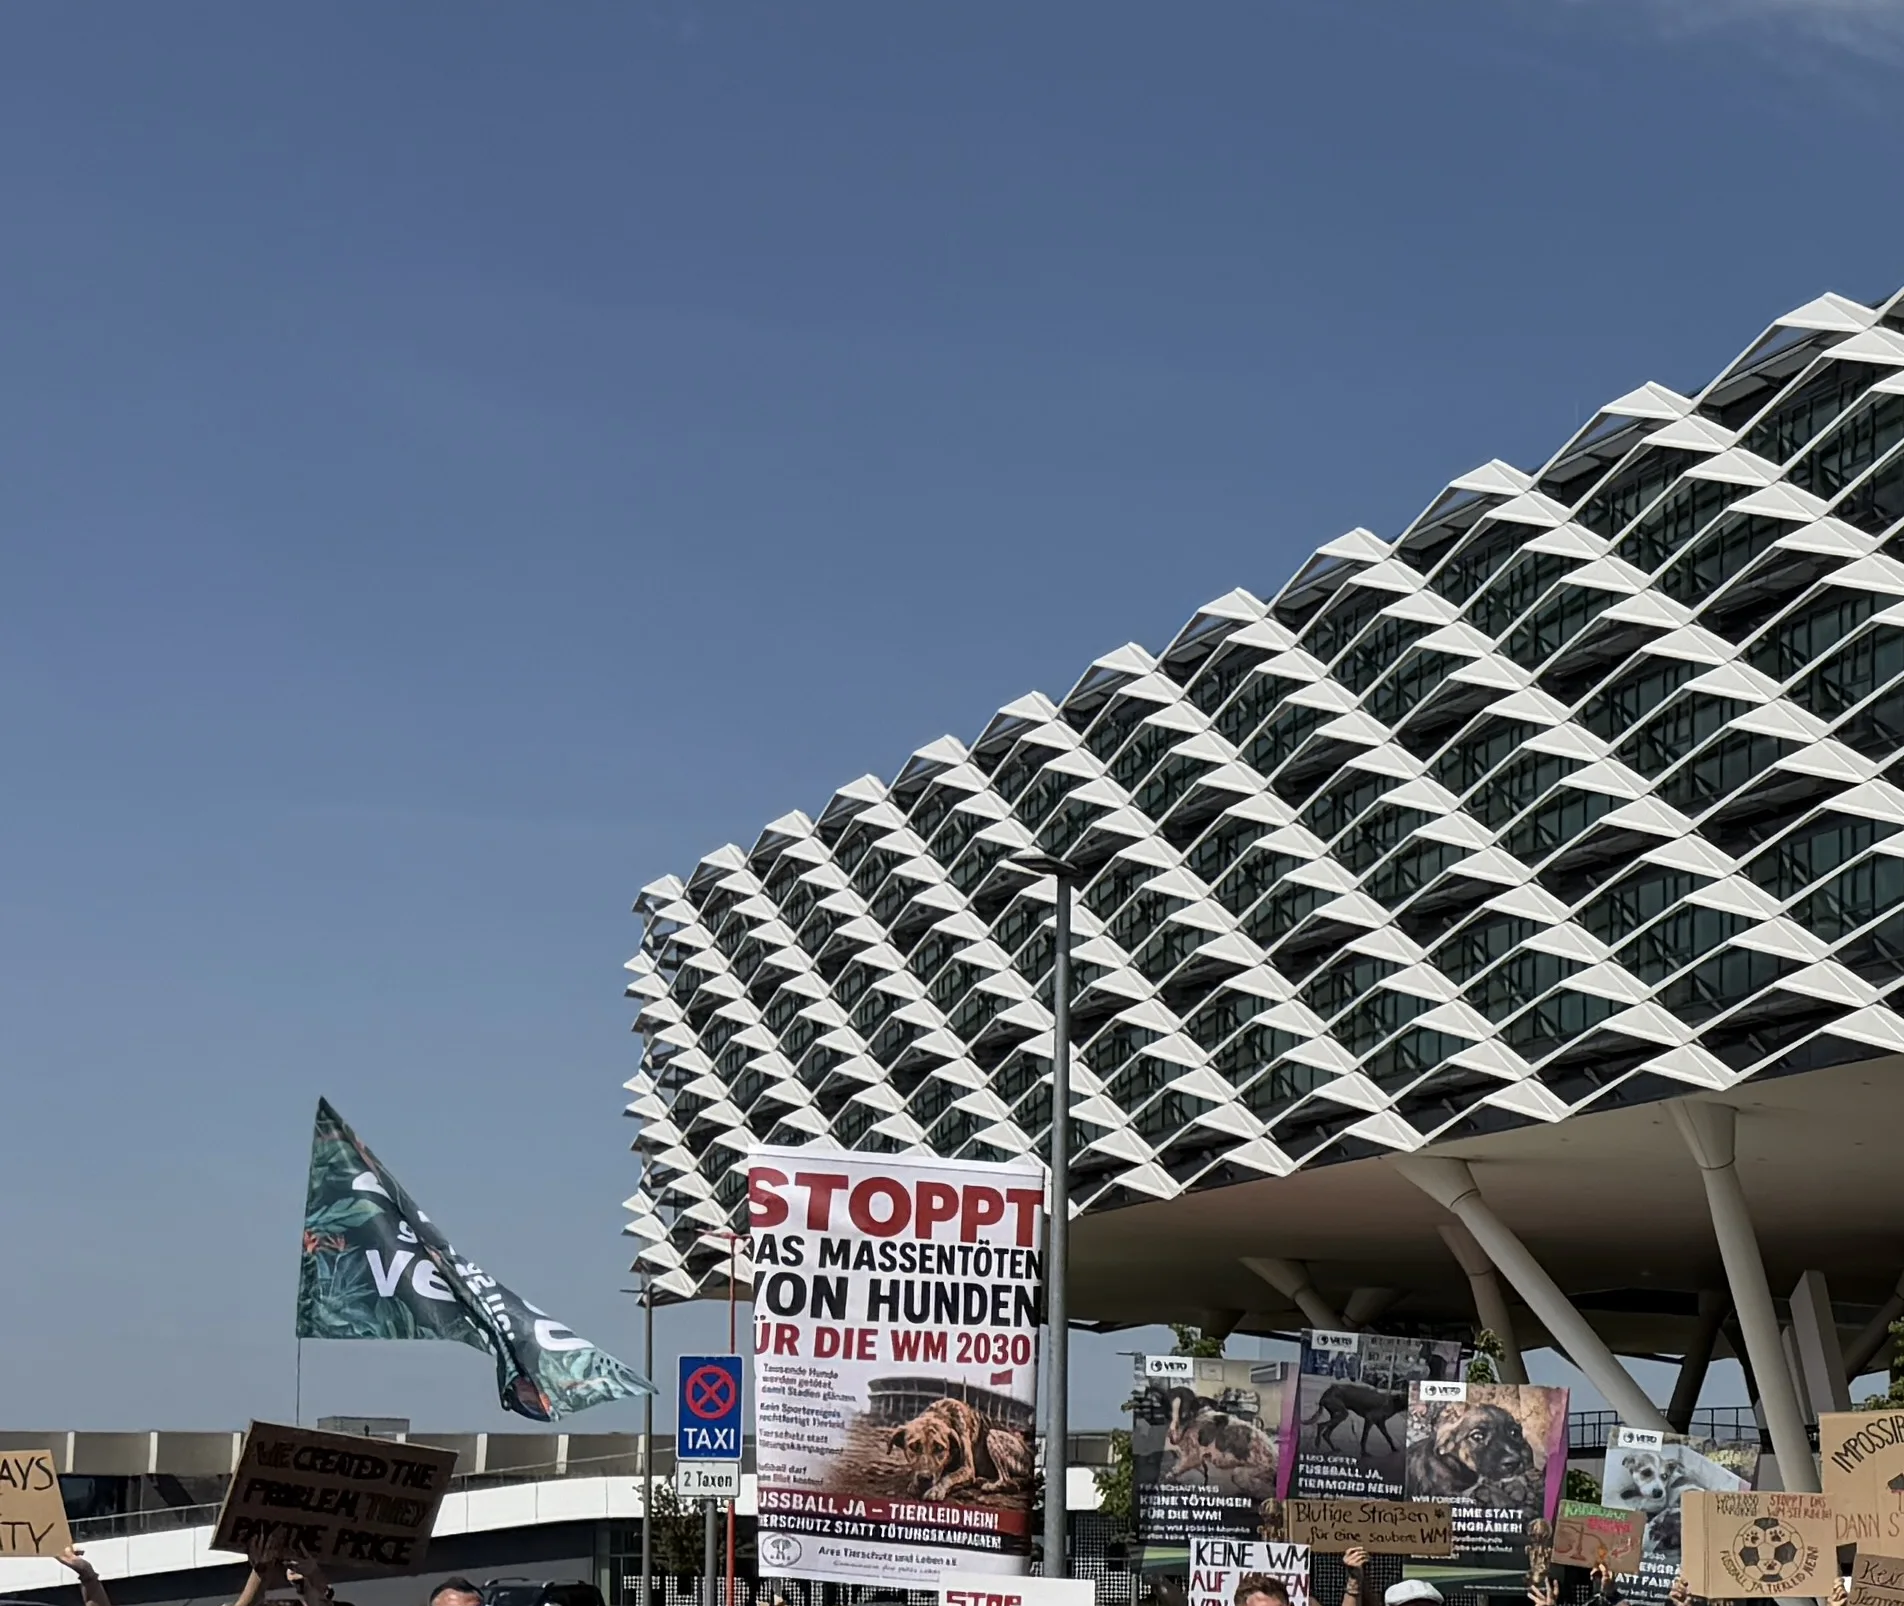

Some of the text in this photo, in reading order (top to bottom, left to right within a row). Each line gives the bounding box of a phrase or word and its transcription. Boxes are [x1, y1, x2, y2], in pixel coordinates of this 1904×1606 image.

[749, 1166, 1044, 1247] STOPPT
[753, 1234, 1043, 1280] AS MASSENTÖTEN
[867, 1278, 1041, 1328] HUNDEN
[814, 1328, 877, 1361] DIE
[891, 1331, 948, 1363] WM
[683, 1427, 735, 1451] TAXI
[683, 1470, 733, 1490] 2 Taxen
[1298, 1478, 1403, 1495] TIERMORD NEIN!
[760, 1491, 999, 1531] USSBALL JA TIERLEID NEIN!
[1181, 1495, 1252, 1508] TÖTUNGEN
[1485, 1508, 1523, 1519] STATT
[758, 1514, 830, 1533] IERSCHUTZ
[834, 1522, 875, 1538] STATT
[1168, 1510, 1188, 1520] DIE
[1295, 1502, 1429, 1528] Blutige Straßen
[1835, 1512, 1880, 1540] DANN
[1306, 1527, 1330, 1544] für
[1335, 1531, 1361, 1542] eine
[1420, 1528, 1449, 1544] WM
[1195, 1540, 1309, 1570] KEINE WM
[1191, 1570, 1231, 1593] AUF
